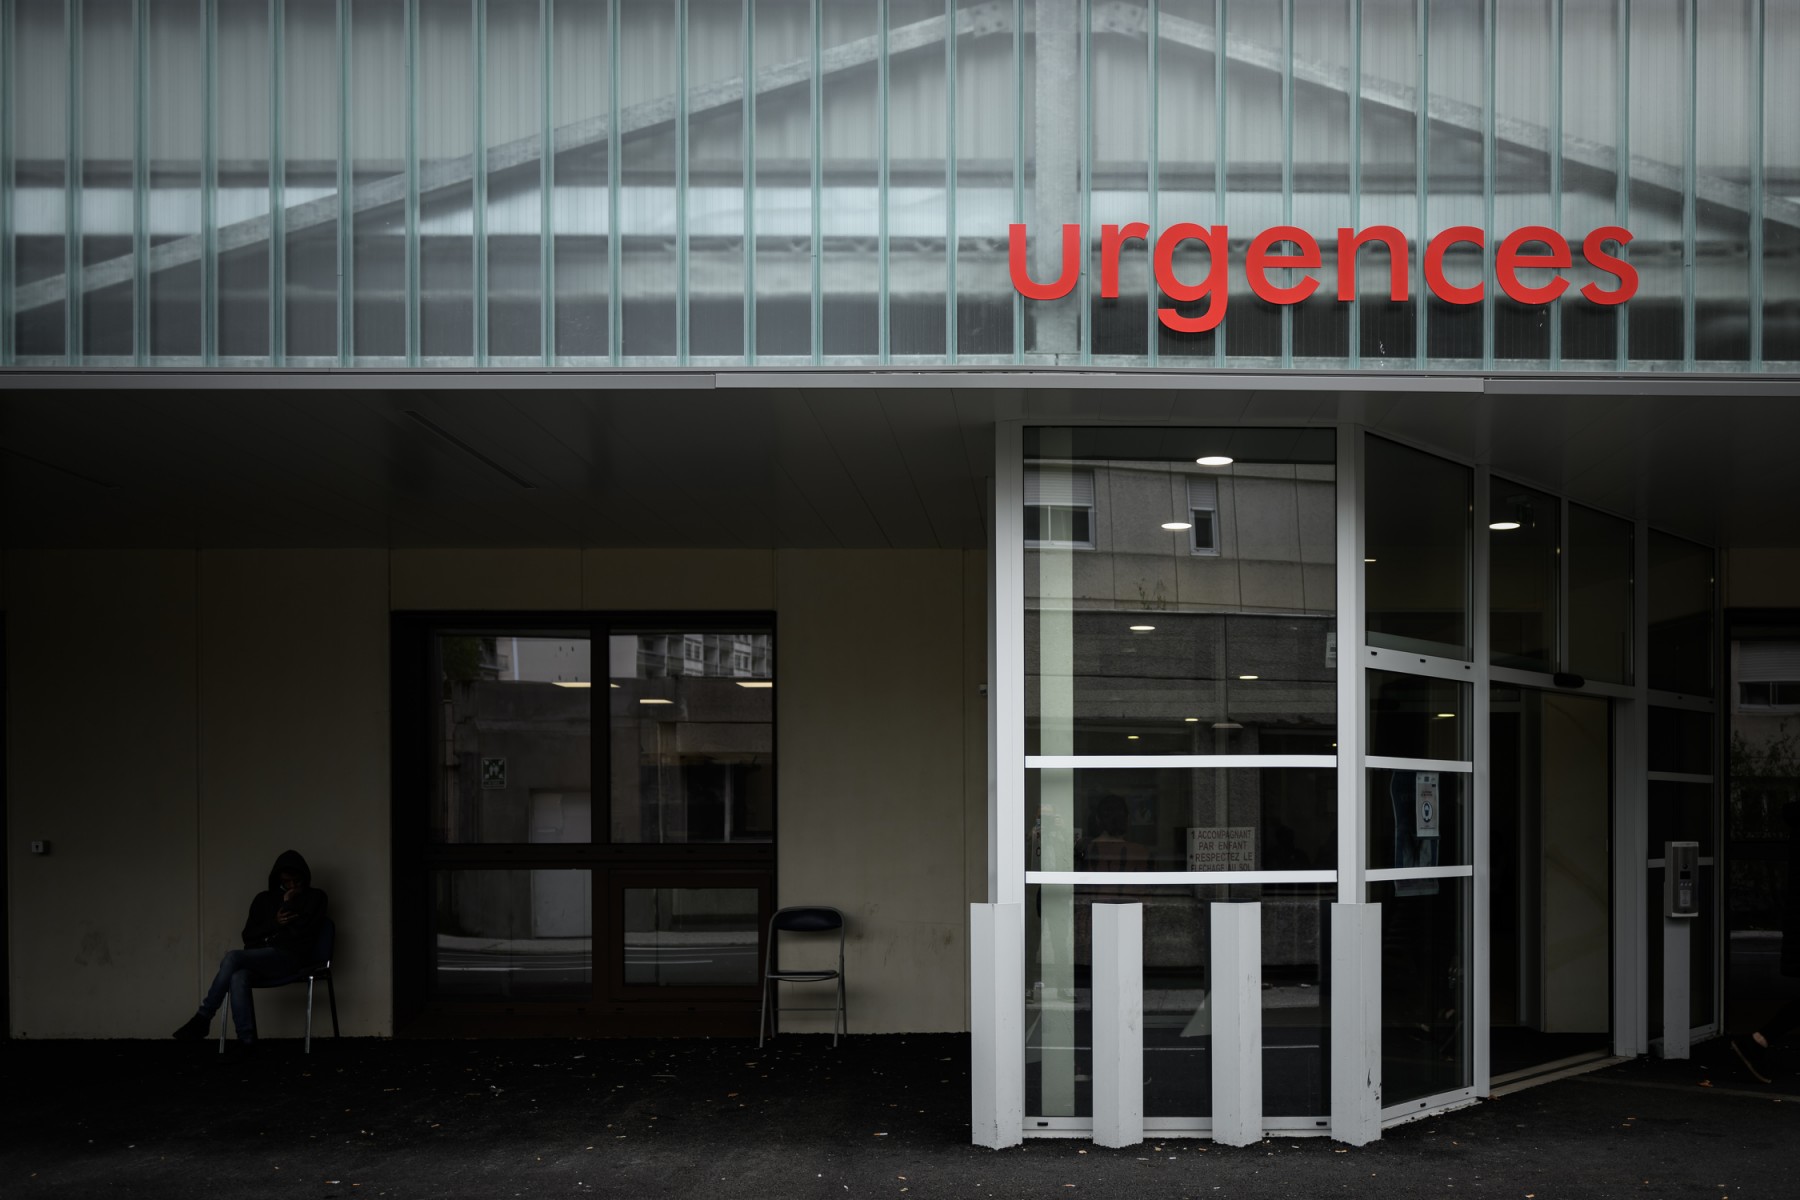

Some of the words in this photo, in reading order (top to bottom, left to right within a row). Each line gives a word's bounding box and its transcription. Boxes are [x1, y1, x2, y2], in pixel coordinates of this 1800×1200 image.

[1008, 221, 1640, 333] urgences
[1197, 829, 1252, 840] ACCOMPAGNANT
[1198, 841, 1214, 851] PAR
[1218, 841, 1248, 851] ENFANT
[1195, 852, 1240, 863] RESPECTEZ
[1243, 852, 1253, 861] LE
